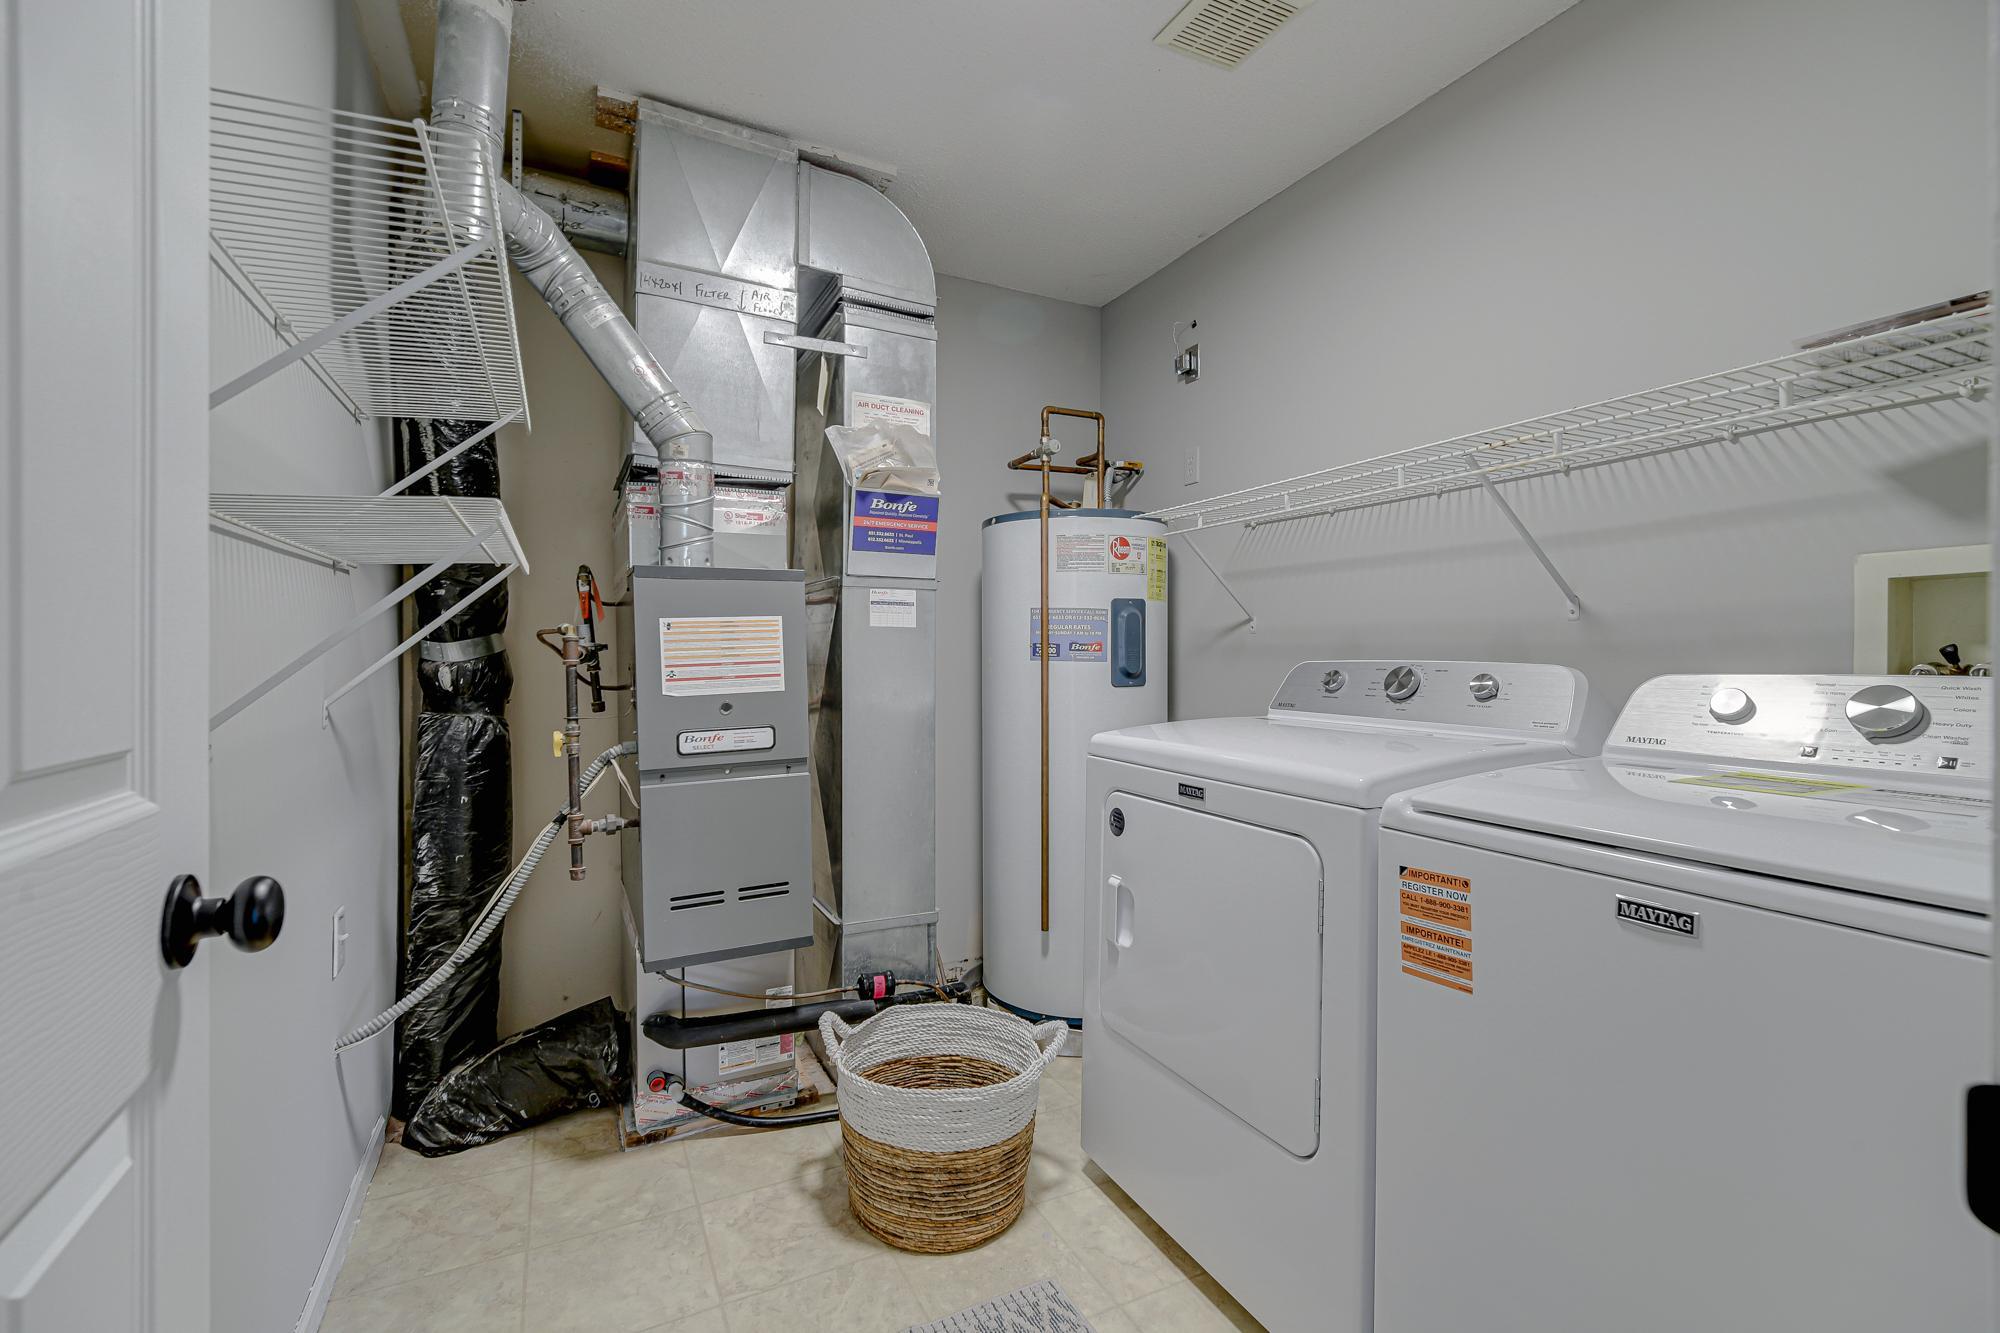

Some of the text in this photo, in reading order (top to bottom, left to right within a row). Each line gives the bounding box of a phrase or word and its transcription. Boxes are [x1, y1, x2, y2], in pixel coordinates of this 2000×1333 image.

[695, 283, 733, 299] FILTER
[751, 289, 771, 302] AIR
[857, 401, 870, 409] AIR
[870, 403, 890, 412] DUCT
[891, 406, 925, 416] CLEANING
[871, 498, 918, 514] Bonfe
[875, 520, 907, 530] EMERGENCY
[1071, 643, 1101, 653] Bonfe
[684, 732, 725, 744] Bonfe
[1625, 735, 1667, 746] MAYTAG
[1179, 784, 1204, 798] MAYTAG
[1408, 869, 1461, 888] IMPORTANT!
[1401, 880, 1468, 902] REGISTER NOW
[1401, 892, 1418, 902] CALL
[1420, 896, 1469, 914] 1-888-900-3381
[1619, 901, 1693, 932] MAYTAG
[1406, 925, 1464, 948] IMPORTANTE!
[1401, 934, 1471, 959] ENREGISTREZ MAINTENANT
[1402, 943, 1425, 955] APPELEZ
